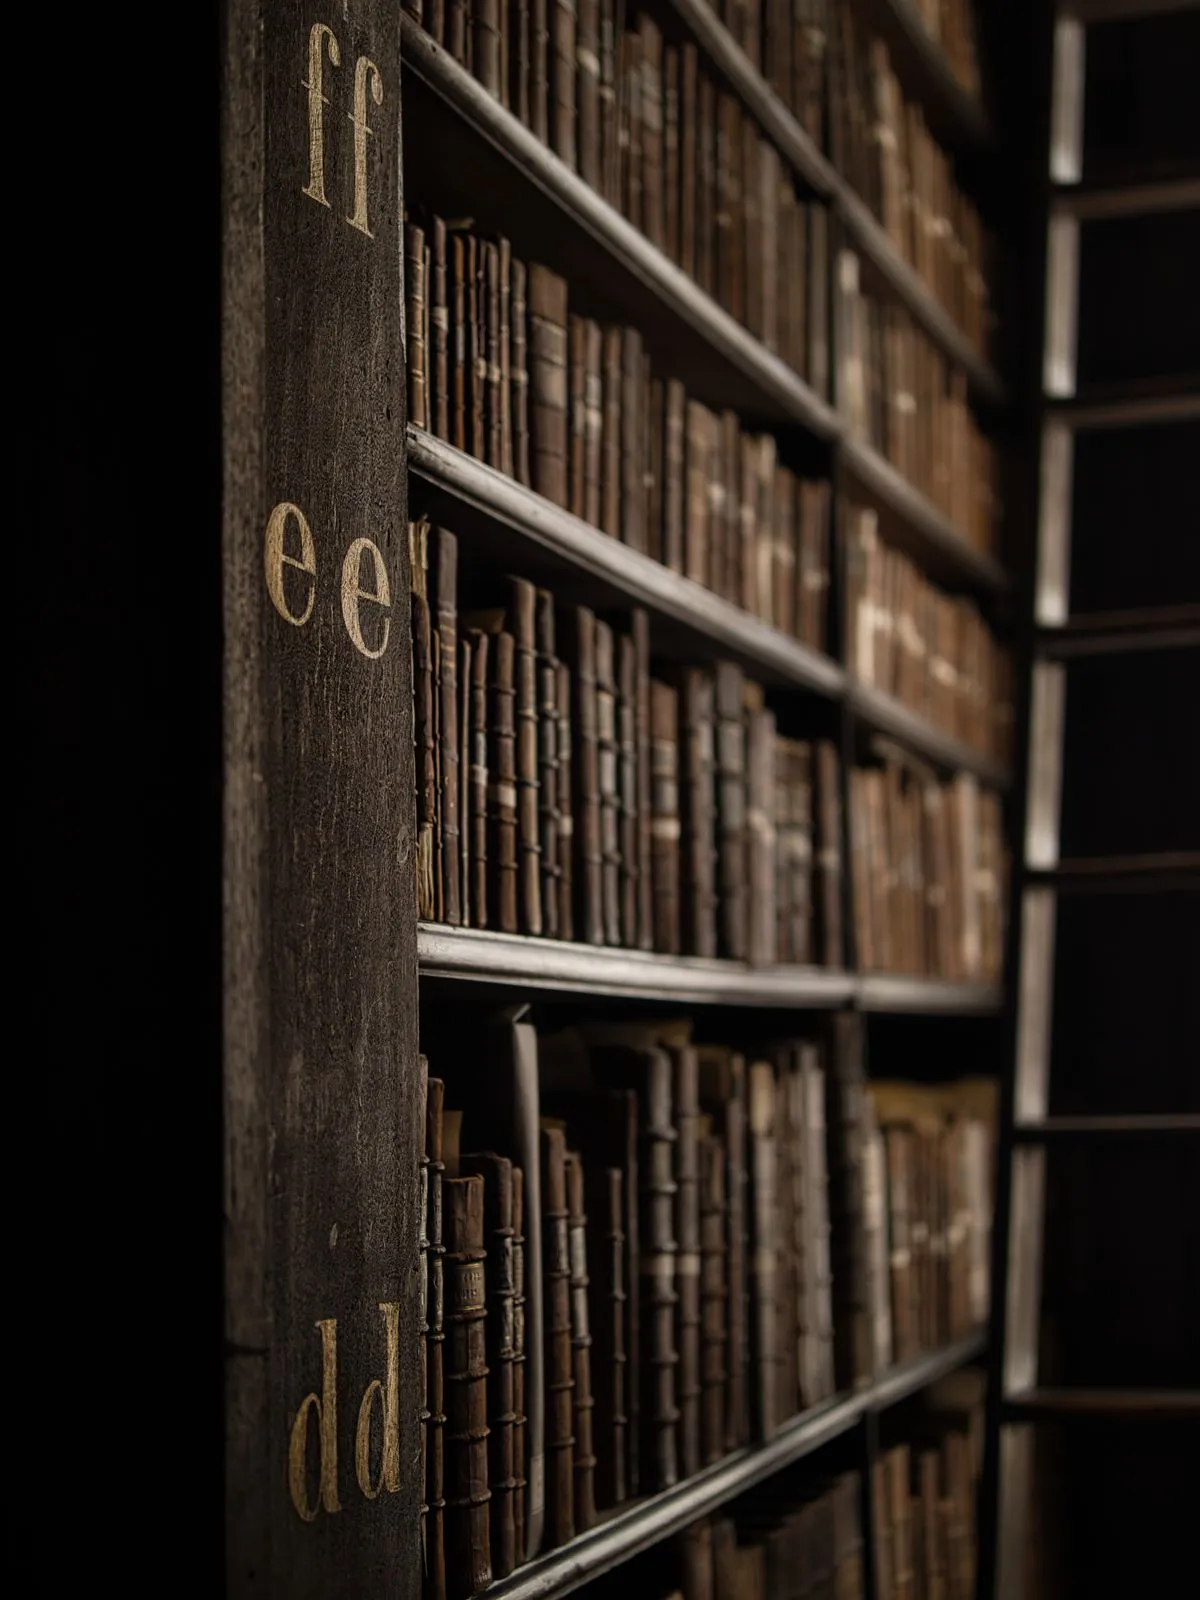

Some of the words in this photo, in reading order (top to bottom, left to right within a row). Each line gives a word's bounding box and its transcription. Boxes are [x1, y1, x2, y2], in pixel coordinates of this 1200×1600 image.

[301, 23, 384, 239] ff
[264, 502, 391, 658] ee
[289, 1302, 401, 1522] dd
